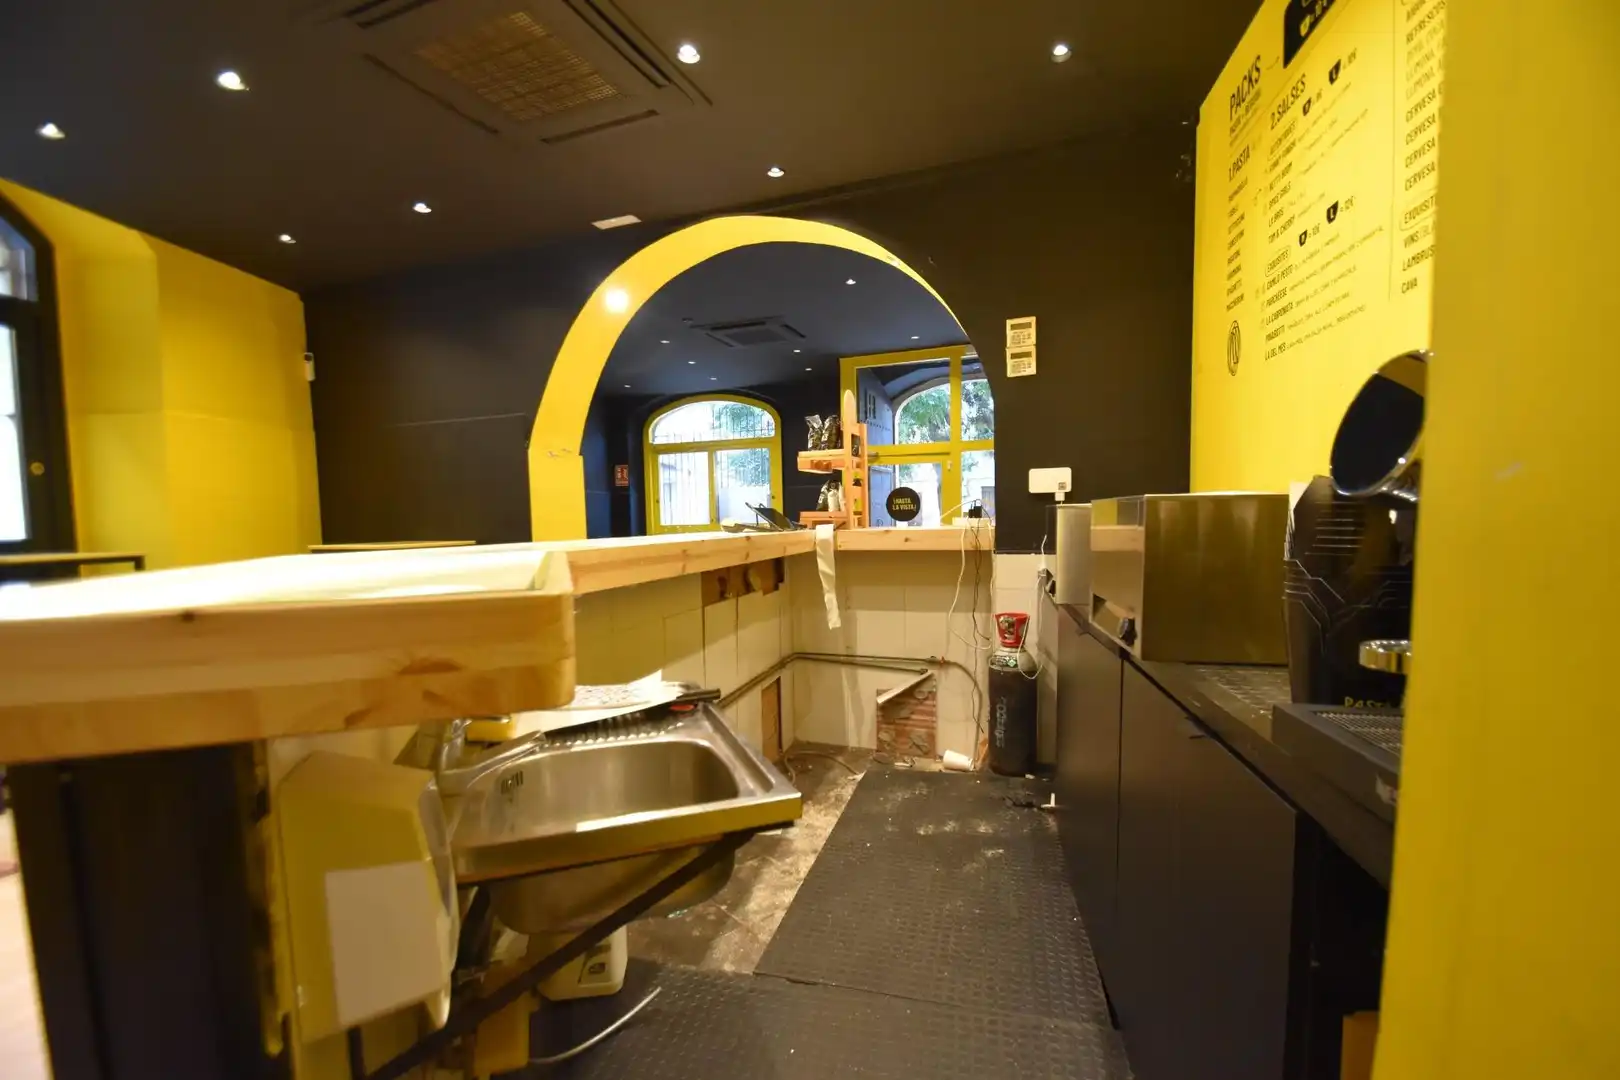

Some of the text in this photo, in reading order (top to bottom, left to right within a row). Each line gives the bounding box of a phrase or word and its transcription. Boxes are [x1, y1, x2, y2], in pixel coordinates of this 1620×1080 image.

[1230, 55, 1261, 121] PACKS
[1406, 88, 1437, 123] CERVESA
[1406, 112, 1436, 145] CERVESA
[1405, 136, 1436, 168] CERVESA
[1405, 161, 1436, 191] CERVESA
[1404, 195, 1436, 224] EXQUISIT
[1402, 244, 1436, 271] LAMBRUS
[1401, 277, 1418, 294] CAVA
